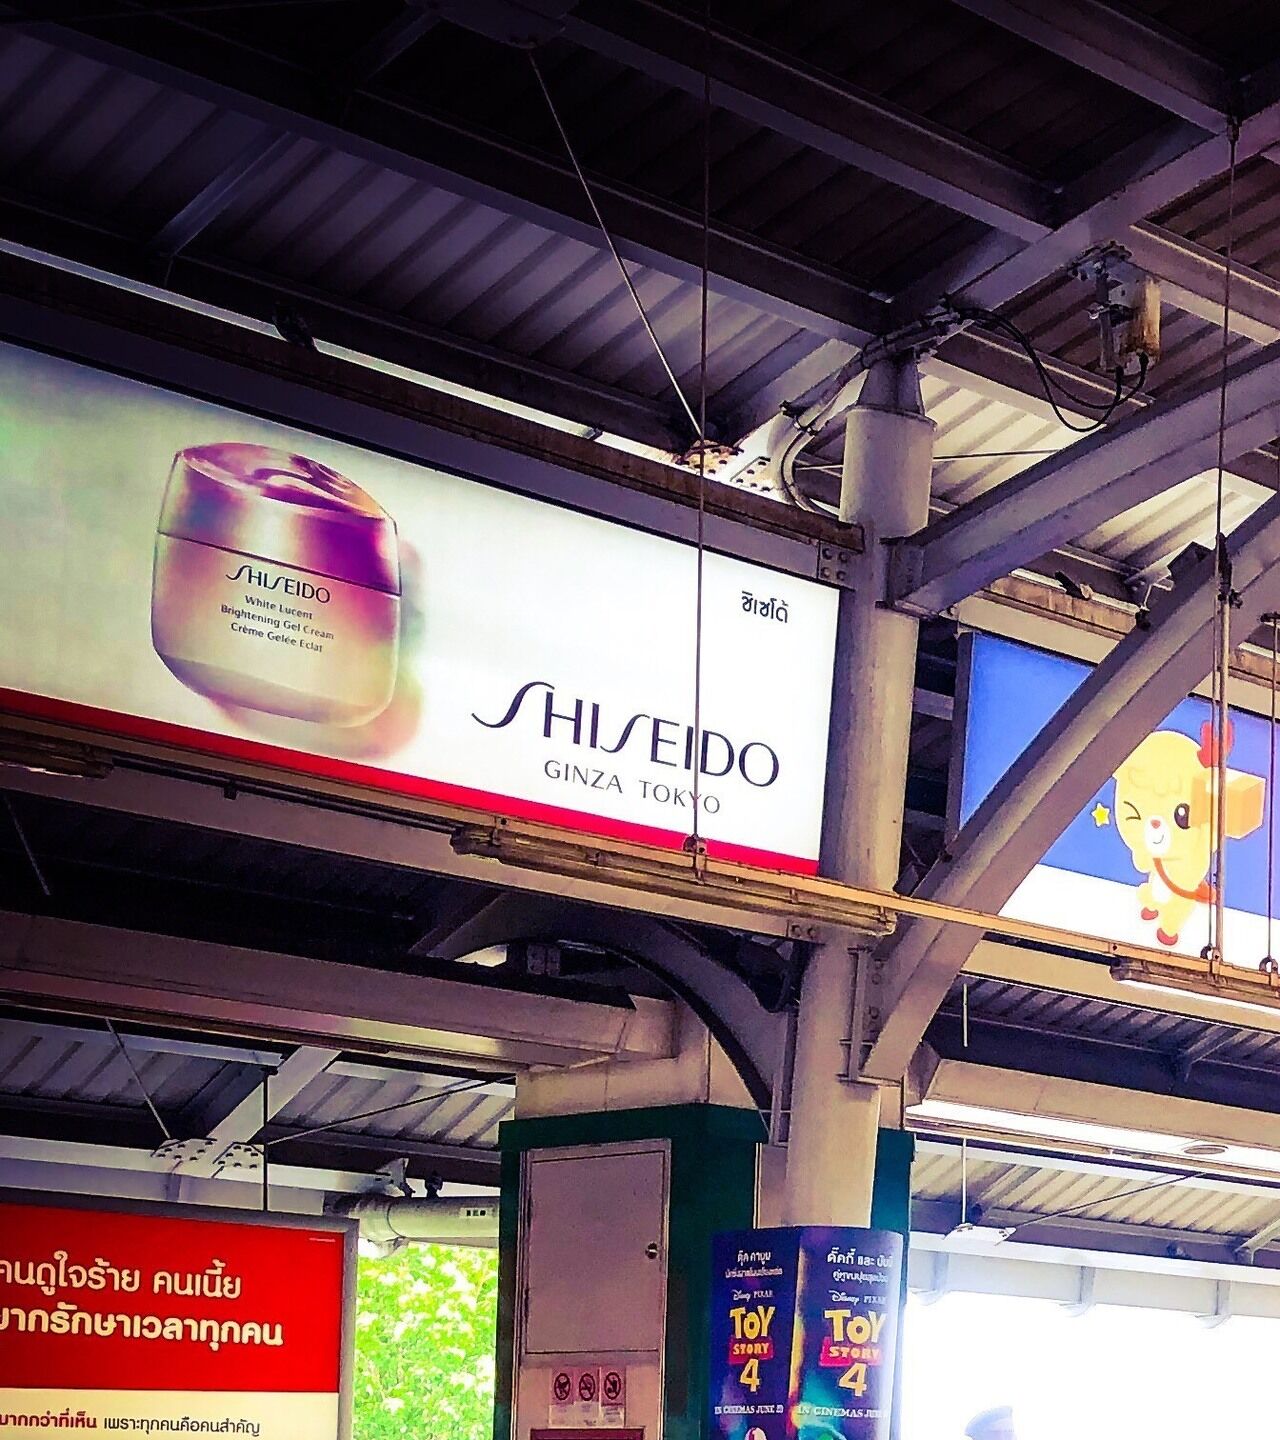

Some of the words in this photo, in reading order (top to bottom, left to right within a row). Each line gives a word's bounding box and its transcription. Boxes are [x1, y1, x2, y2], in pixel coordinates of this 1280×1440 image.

[225, 565, 331, 604] SHISEIDO
[220, 604, 280, 628] Brightening
[283, 620, 301, 632] Gel
[303, 625, 334, 640] Cream
[245, 595, 277, 611] White
[279, 604, 313, 620] Lucent
[230, 622, 264, 638] Crème
[471, 681, 780, 788] SHISEIDO
[544, 760, 623, 794] GINZA
[638, 780, 721, 814] TOKYO
[153, 1259, 242, 1299] คนเนี้ย
[828, 1290, 860, 1306] Disney
[729, 1305, 776, 1340] TOY
[824, 1309, 888, 1344] TOY
[732, 1342, 770, 1356] STORY
[829, 1345, 882, 1359] STORY
[739, 1358, 761, 1393] 4
[838, 1362, 868, 1397] 4
[797, 1402, 811, 1415] IN
[813, 1406, 863, 1418] CINEMAS
